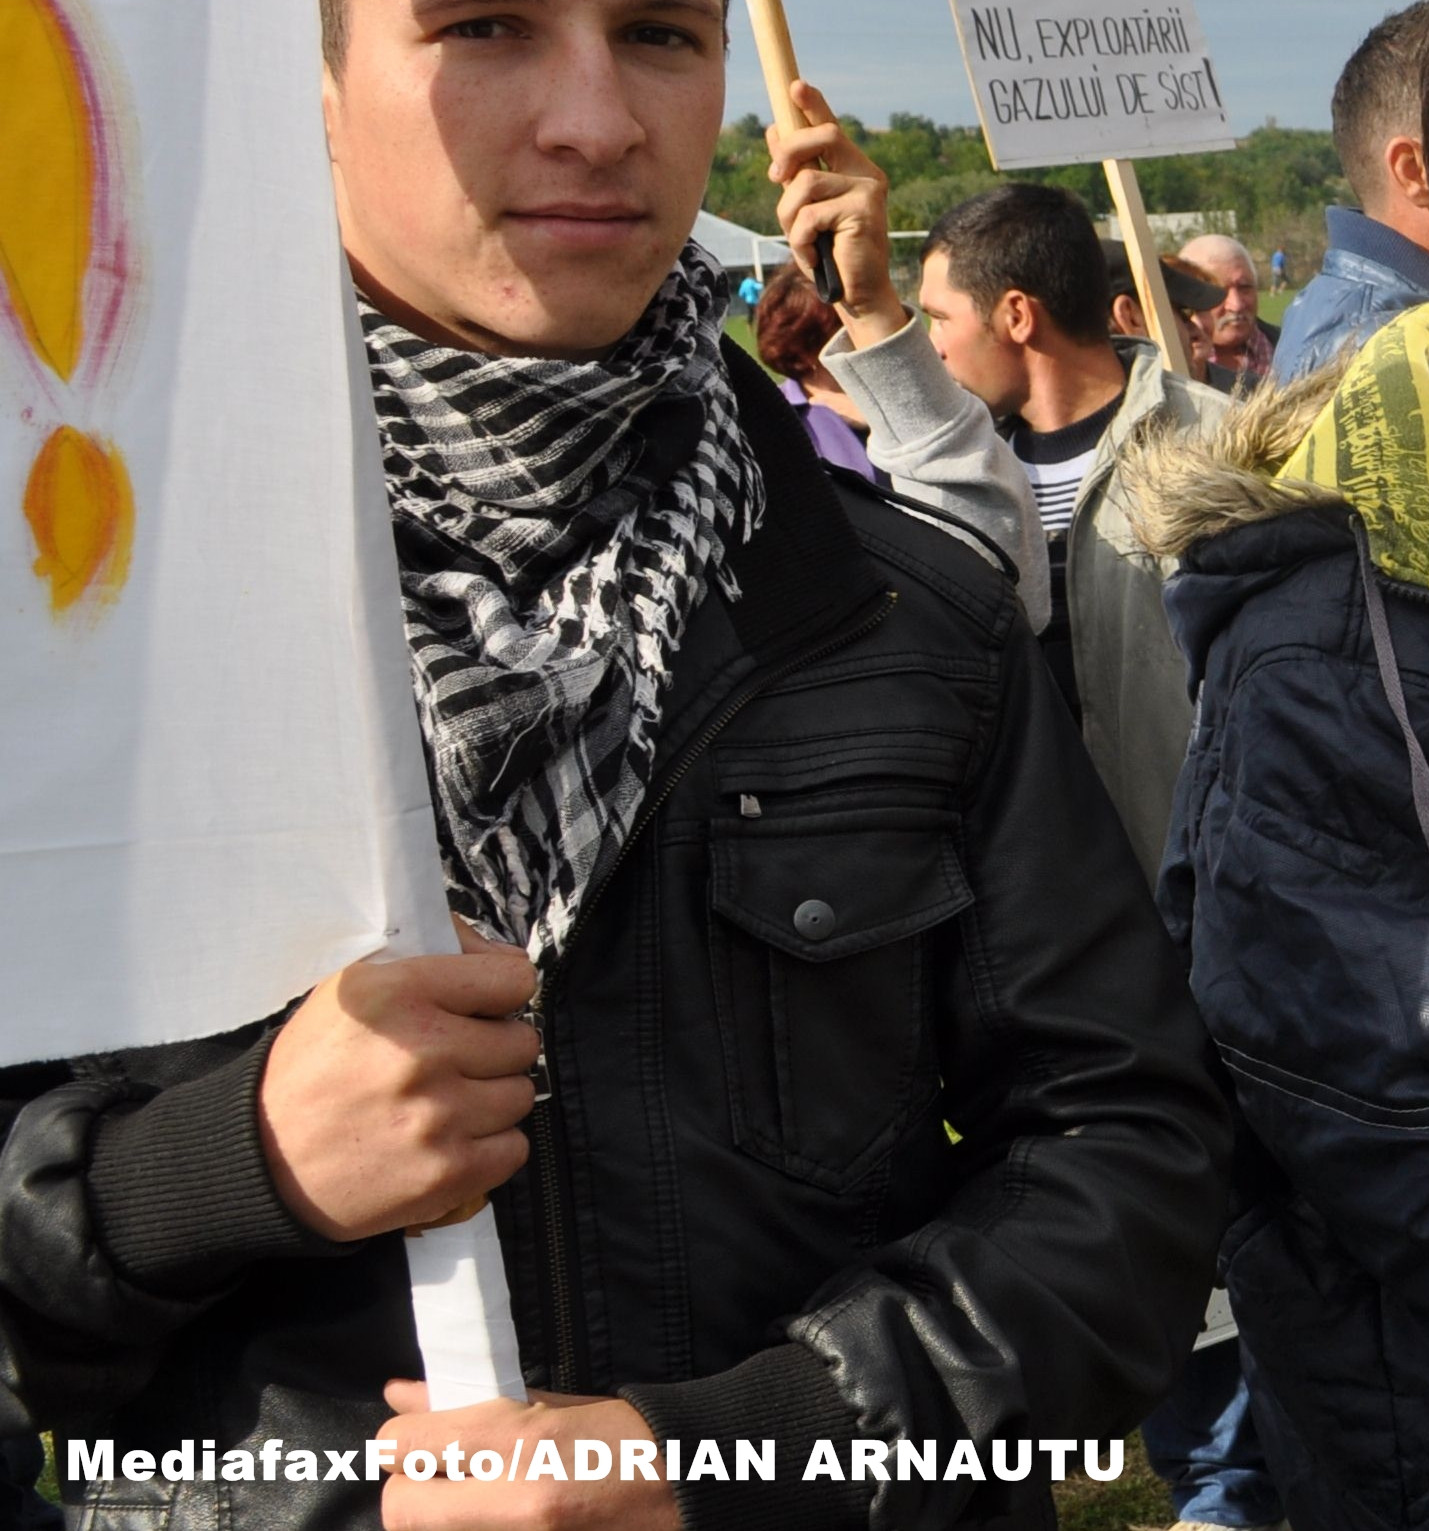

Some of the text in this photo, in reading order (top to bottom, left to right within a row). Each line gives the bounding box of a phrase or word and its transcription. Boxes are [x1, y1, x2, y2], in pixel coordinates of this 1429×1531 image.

[971, 6, 1034, 64] NU,
[988, 63, 1109, 124] GAZULUI
[1115, 72, 1155, 116] DE
